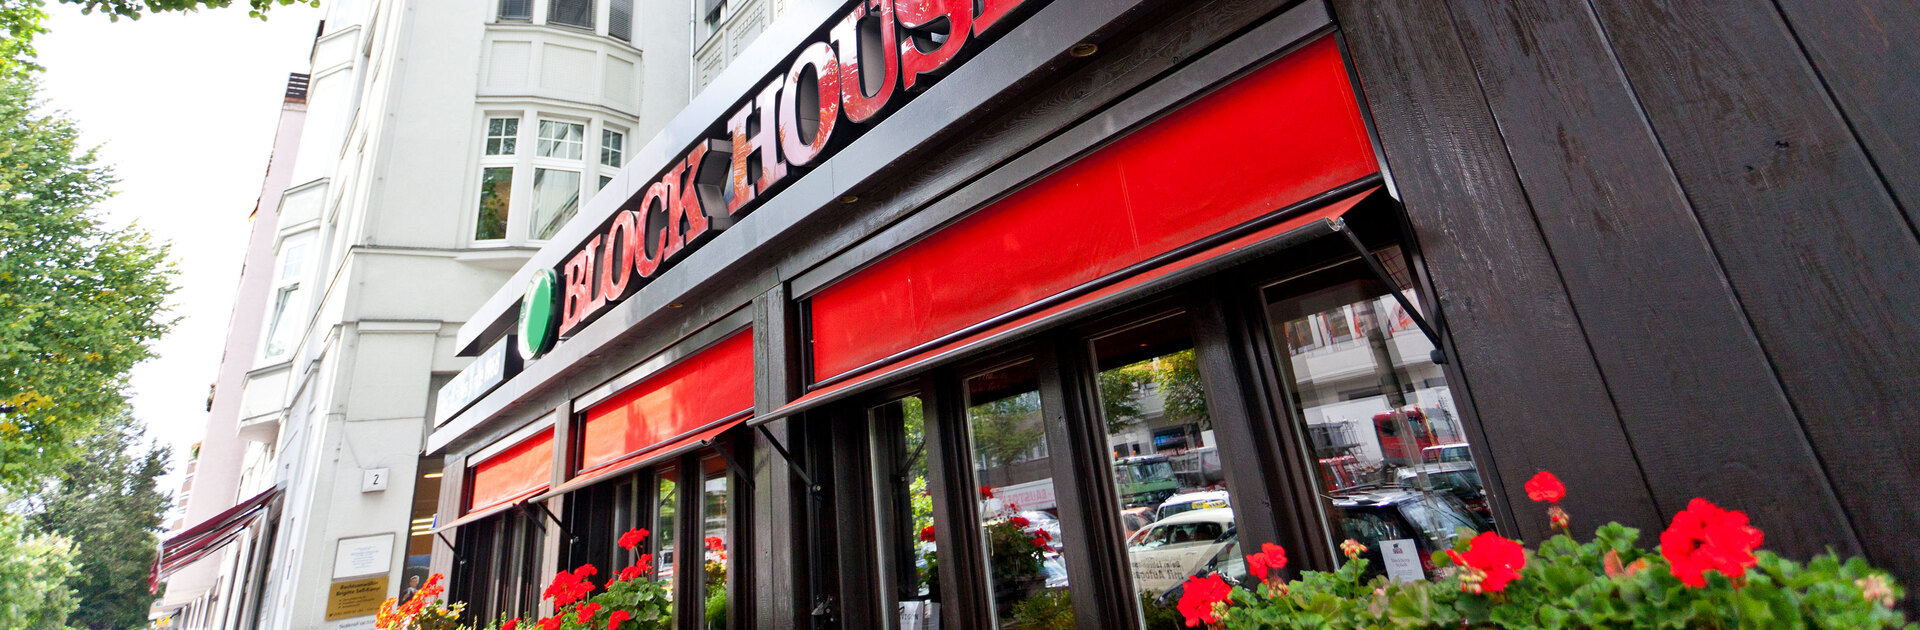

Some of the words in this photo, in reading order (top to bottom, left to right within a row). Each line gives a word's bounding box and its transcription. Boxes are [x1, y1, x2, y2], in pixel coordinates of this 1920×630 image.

[559, 138, 709, 337] BLOCK
[726, 0, 1026, 216] HOUS
[373, 474, 379, 485] 2
